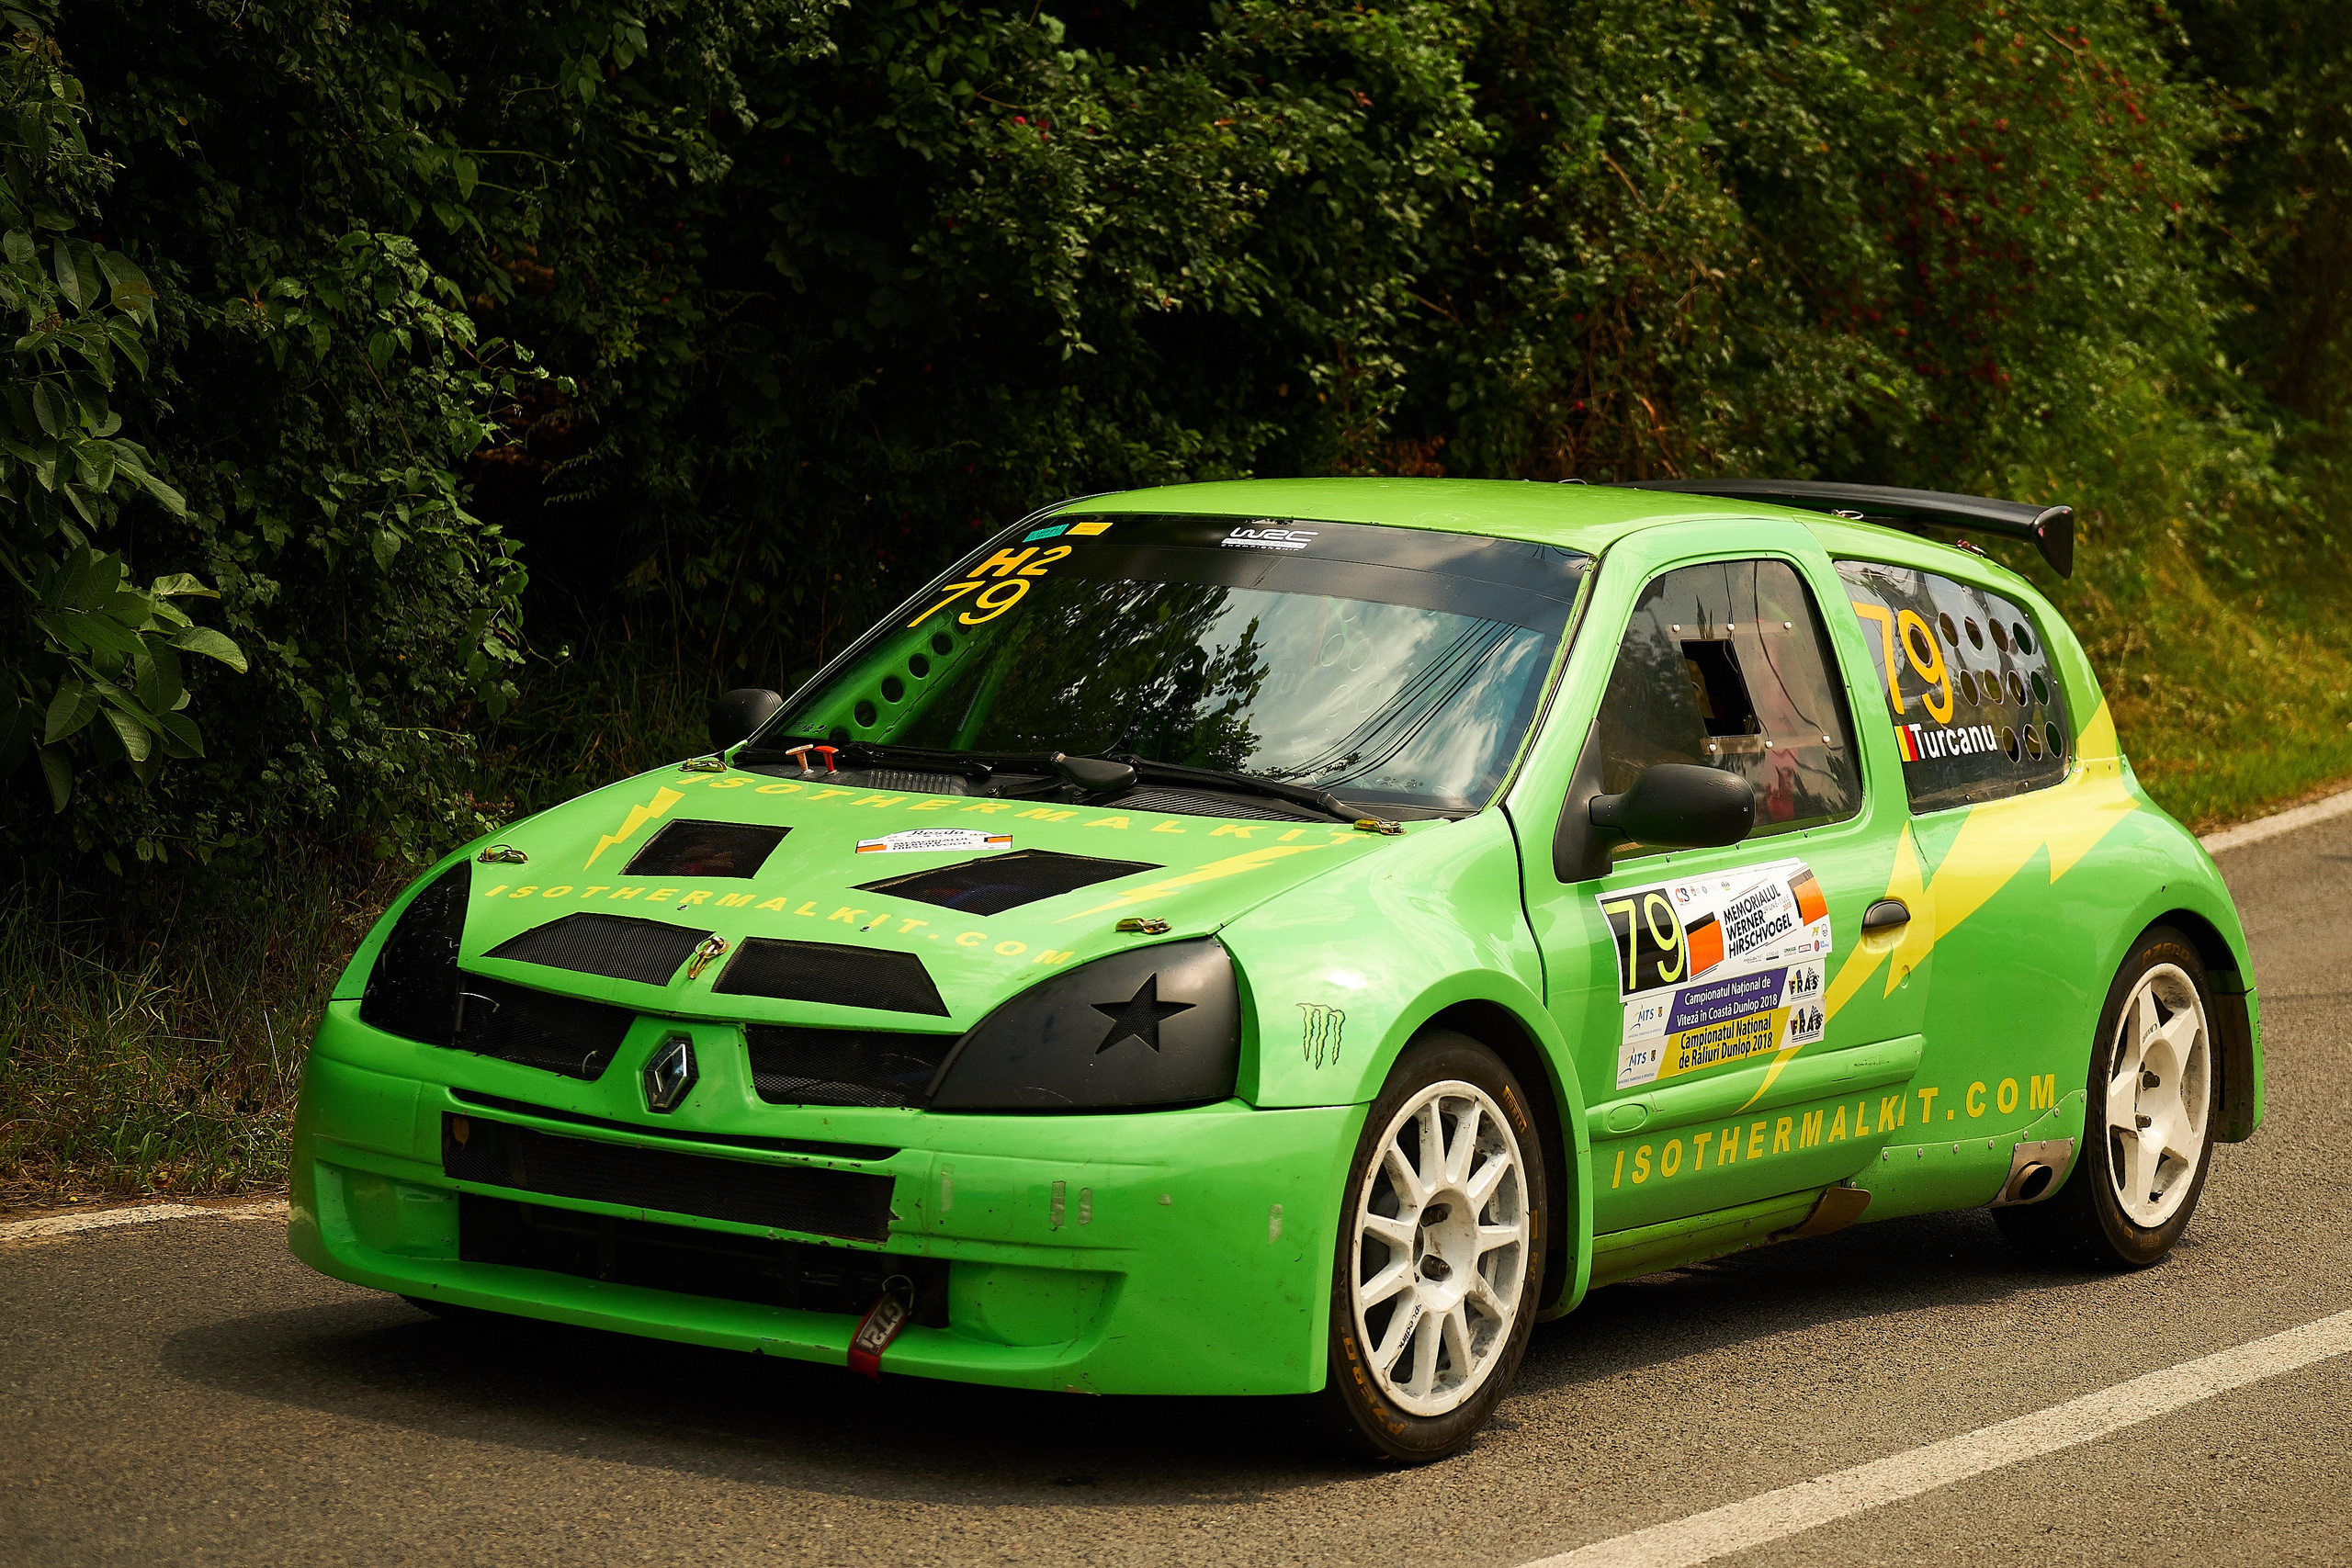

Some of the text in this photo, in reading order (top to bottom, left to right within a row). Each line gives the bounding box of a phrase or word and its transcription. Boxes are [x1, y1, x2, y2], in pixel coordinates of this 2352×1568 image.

[1229, 526, 1319, 542] WRC
[967, 545, 1072, 578] H2
[907, 579, 1031, 626] 79
[1851, 601, 1954, 724] 79
[1908, 723, 1998, 760] Turcanu
[1723, 884, 1781, 926] MEMORIALUL
[483, 884, 1077, 967] ISOTHERMALKIT.COM
[1603, 893, 1685, 990] 79
[1726, 909, 1766, 942] WERNER
[1728, 913, 1792, 958] HIRSCHVOGEL
[1684, 983, 1729, 1006] Campionatul
[1761, 975, 1771, 988] de
[1790, 974, 1819, 995] FRAS
[1677, 1010, 1698, 1028] Viteză
[1708, 1003, 1733, 1020] Coastă
[1733, 998, 1759, 1015] Dunlop
[1759, 993, 1778, 1009] 2018
[1791, 1013, 1823, 1035] FRAS
[1679, 1050, 1690, 1070] de
[1691, 1044, 1721, 1067] Raliuri
[1721, 1038, 1751, 1058] Dunlop
[1751, 1031, 1773, 1052] 2018
[1680, 1021, 1734, 1051] Campionatul
[1611, 1073, 2055, 1190] ISOTHERMALKIT.COM
